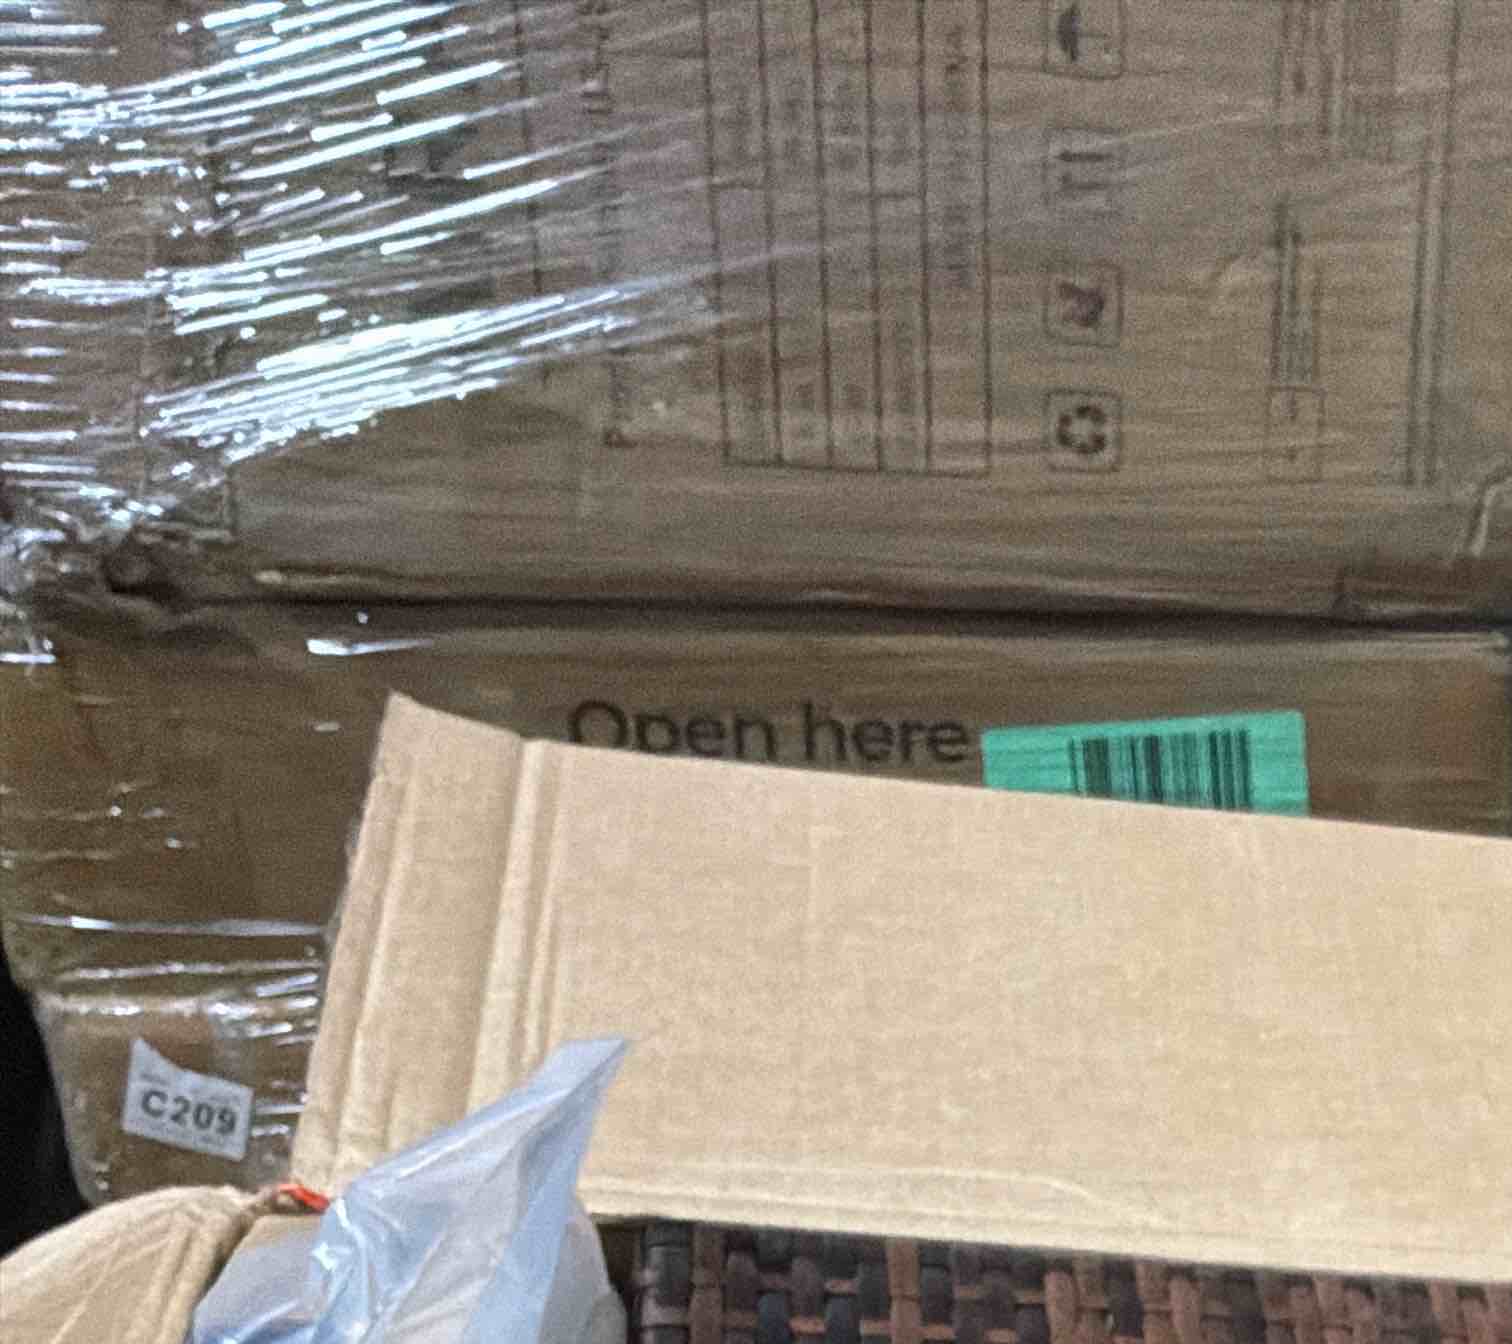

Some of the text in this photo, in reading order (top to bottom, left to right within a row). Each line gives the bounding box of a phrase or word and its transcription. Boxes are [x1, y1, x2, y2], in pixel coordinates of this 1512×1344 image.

[569, 700, 971, 764] Open here
[140, 1089, 237, 1136] C209
